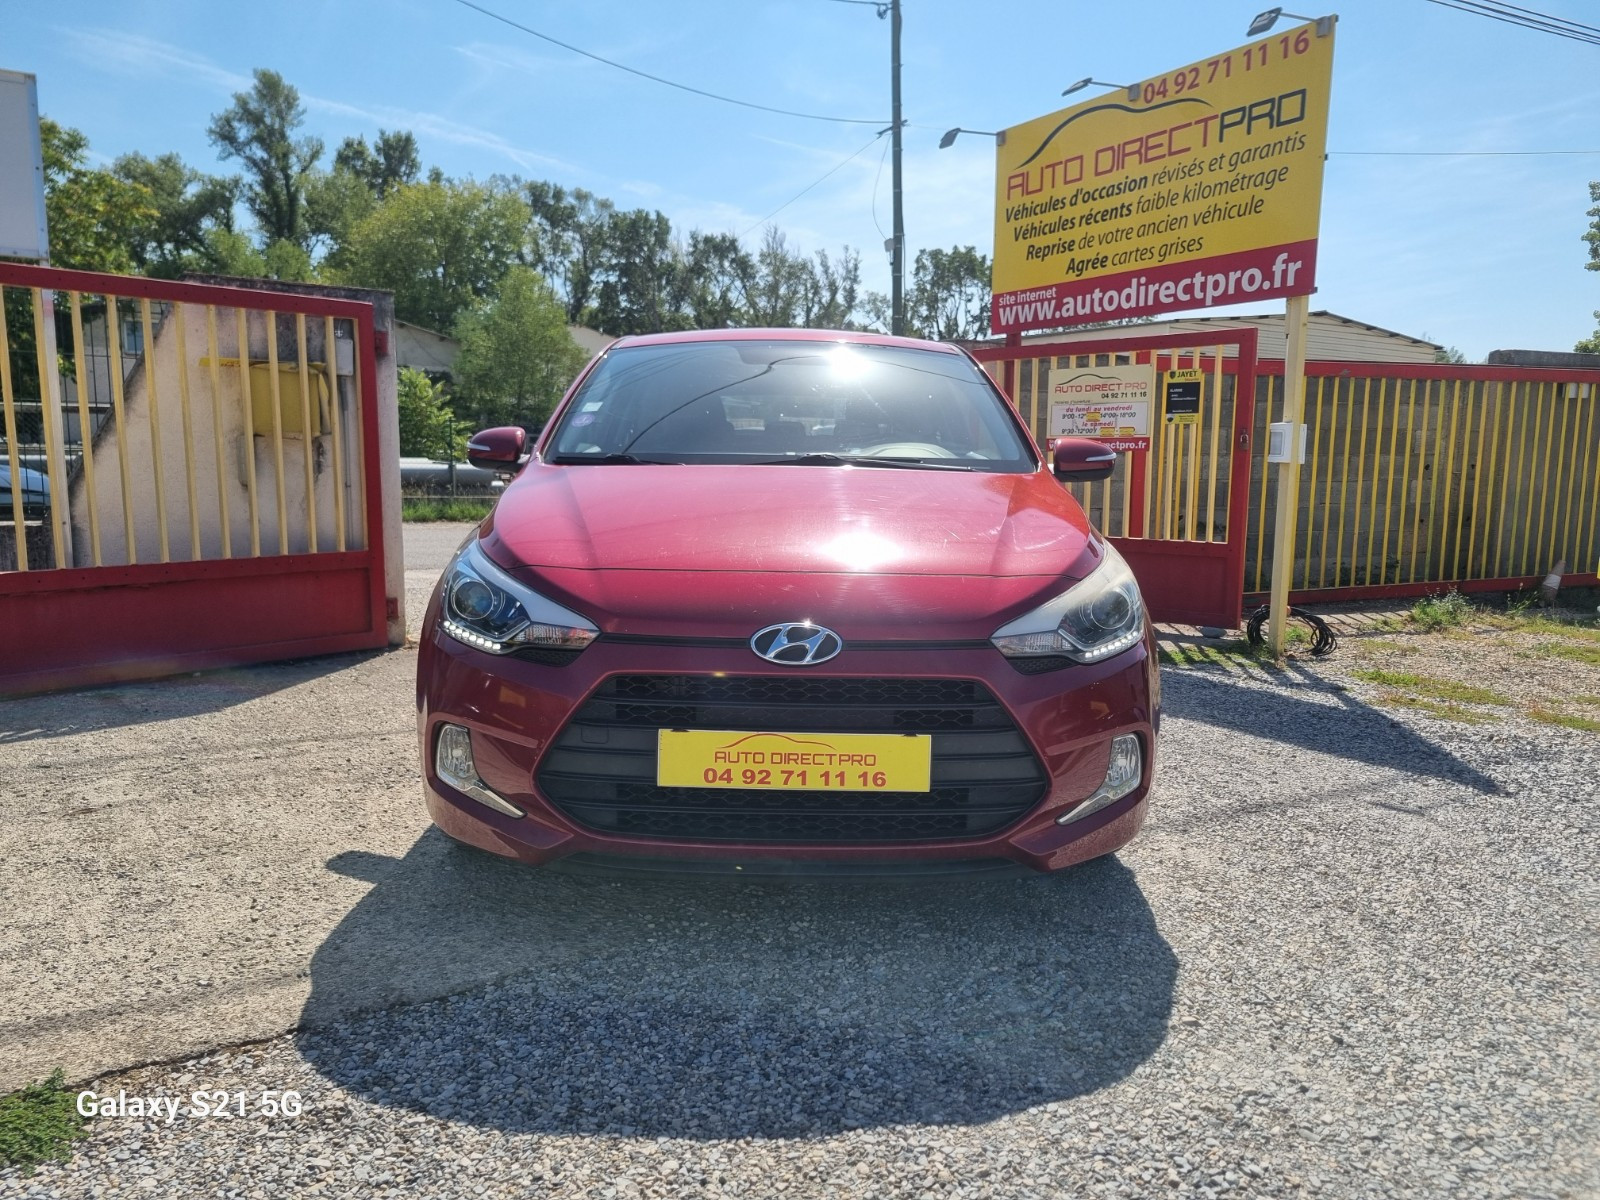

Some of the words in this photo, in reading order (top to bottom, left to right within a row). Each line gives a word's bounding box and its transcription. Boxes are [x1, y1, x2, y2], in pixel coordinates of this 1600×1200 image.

[1143, 77, 1168, 104] 04
[1174, 67, 1200, 95] 92
[1207, 55, 1232, 83] 71
[1243, 43, 1268, 71] 11
[1280, 29, 1310, 59] 16
[1005, 195, 1066, 223] Véhicules
[1069, 175, 1149, 207] d'occasion
[1151, 157, 1205, 187] révisés
[1208, 152, 1226, 172] et
[1228, 131, 1307, 173] garantis
[1007, 154, 1084, 200] AUTO
[1014, 215, 1076, 242] Véhicules
[1078, 202, 1132, 228] récents
[1135, 189, 1180, 215] faible
[1182, 166, 1289, 204] kilométrage
[1026, 238, 1076, 262] Reprise
[1078, 232, 1095, 250] de
[1098, 226, 1134, 246] votre
[1136, 214, 1189, 238] ancien
[1193, 194, 1265, 226] véhicule
[1065, 252, 1108, 277] Agrée
[1111, 246, 1155, 267] cartes
[1158, 236, 1204, 262] grises
[998, 252, 1302, 326] www.autodirectpro.fr
[998, 294, 1015, 306] site
[1016, 286, 1057, 304] internet
[1055, 384, 1083, 394] AUTO
[1085, 382, 1123, 393] DIRECT
[1124, 381, 1148, 390] PRO
[1177, 370, 1198, 378] JAYET
[703, 768, 733, 784] 04
[741, 769, 771, 785] 92
[780, 770, 807, 786] 71
[819, 771, 846, 786] 11
[857, 771, 887, 787] 16
[714, 751, 765, 764] AUTO
